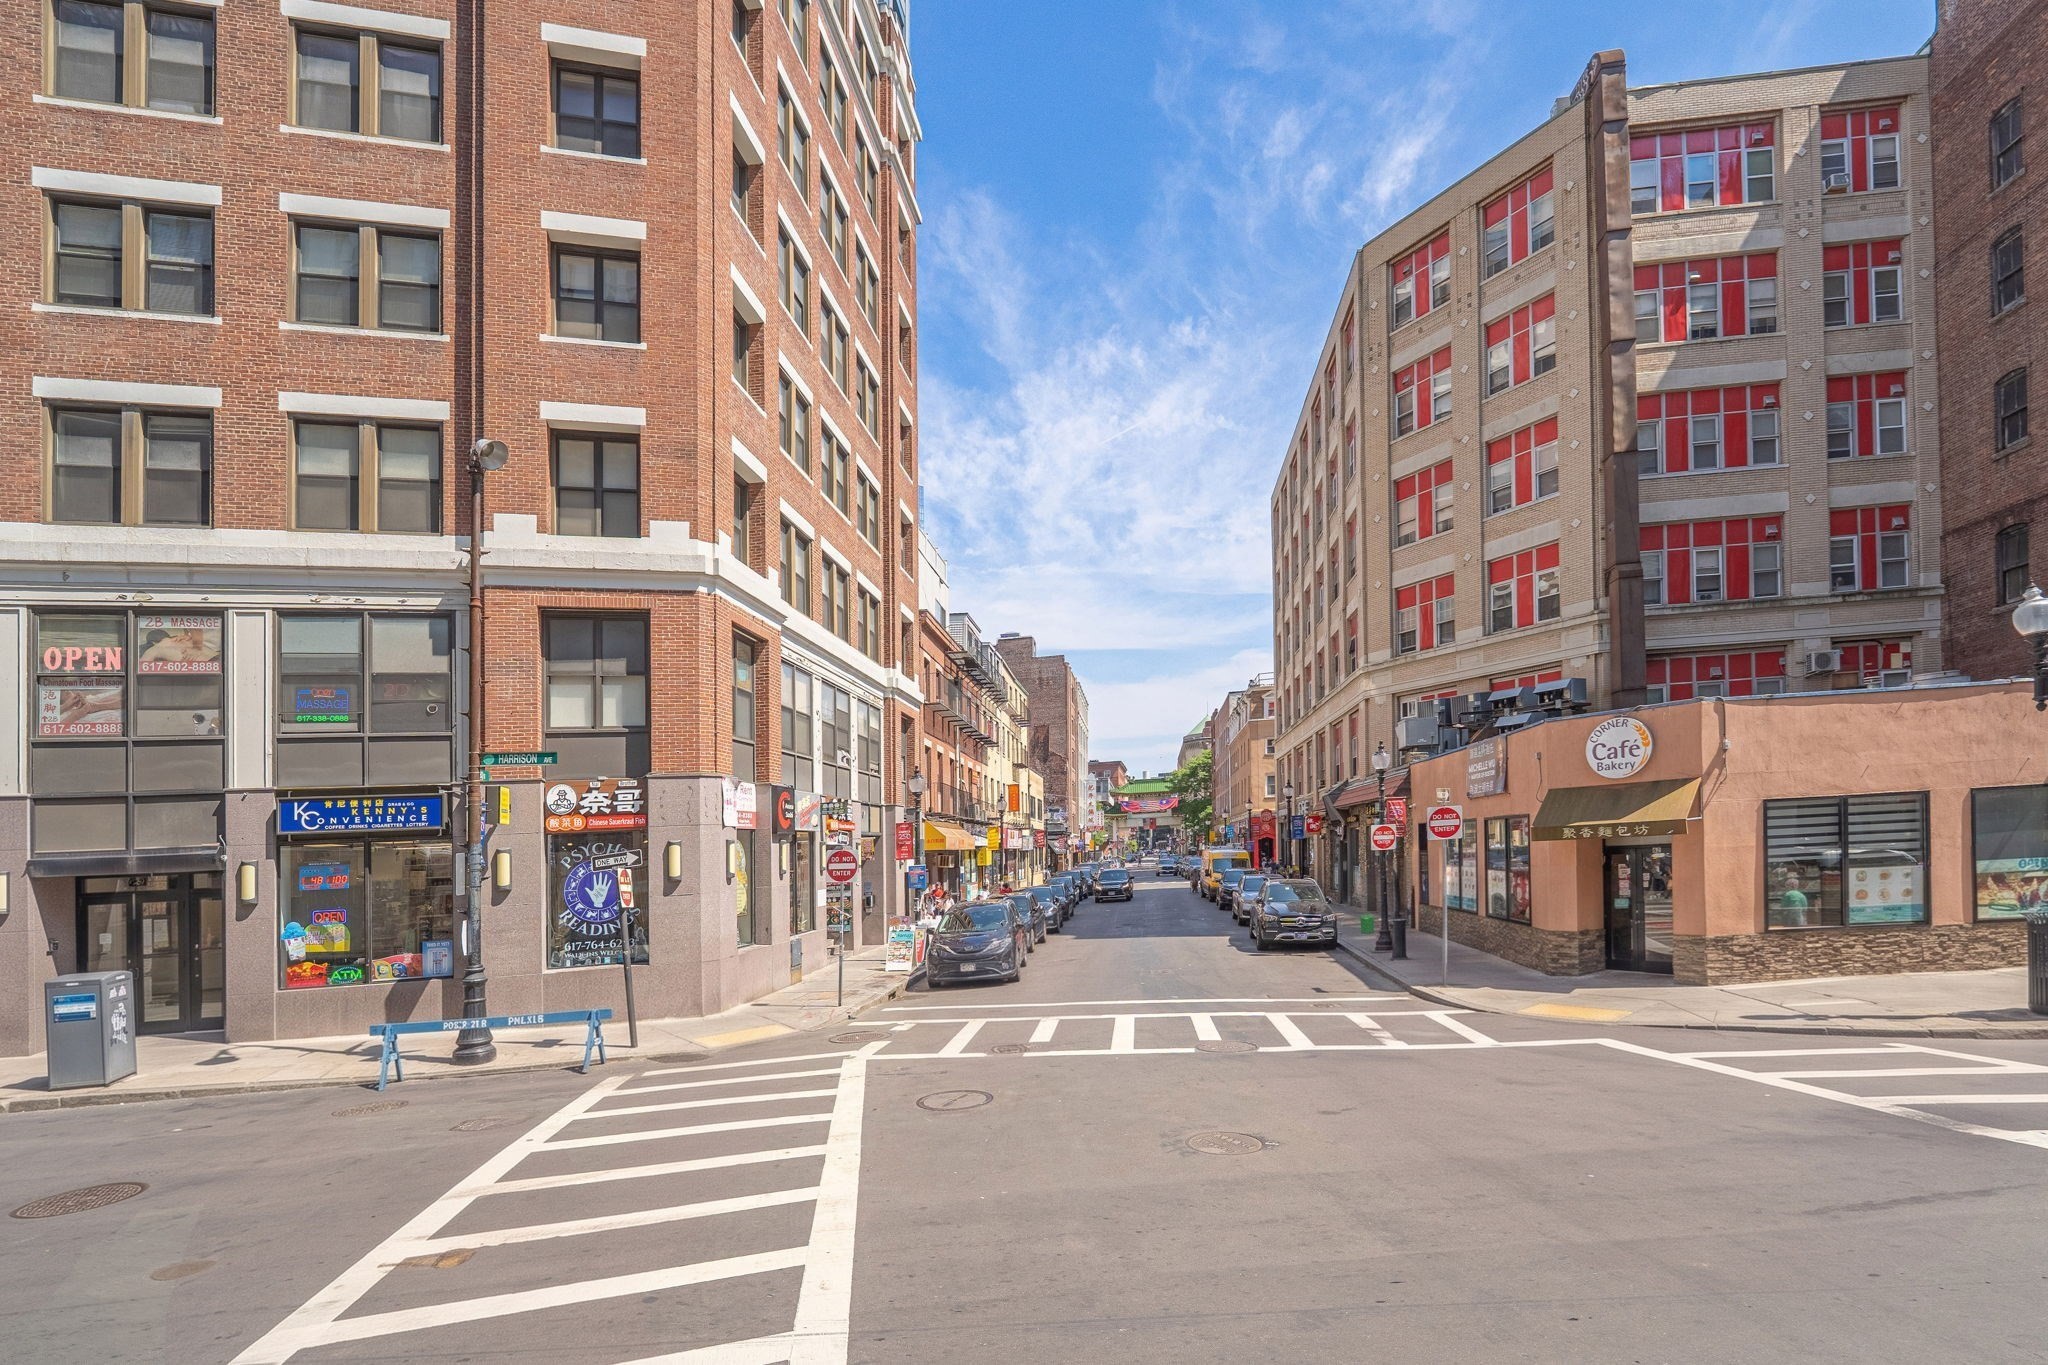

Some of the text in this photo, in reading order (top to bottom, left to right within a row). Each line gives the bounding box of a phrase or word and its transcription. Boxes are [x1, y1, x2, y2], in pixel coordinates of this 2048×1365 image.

[144, 617, 220, 628] 2B MASSAGE
[43, 647, 122, 671] OPEN
[142, 662, 219, 671] 617-602-8888
[43, 678, 123, 688] Chinatown Foot Massage
[299, 699, 348, 709] MASSAGE
[43, 724, 122, 733] 617-602-8888
[1590, 719, 1628, 743] CORNER
[1592, 739, 1640, 761] Café
[498, 754, 537, 764] HARRISON
[1597, 761, 1636, 772] Bakery
[579, 789, 645, 814] 奈哥
[351, 806, 427, 815] KENNY'S
[609, 818, 634, 826] Sauerkraut
[314, 912, 345, 923] OPEN
[564, 939, 635, 952] 617-764-623
[331, 970, 362, 981] ATM
